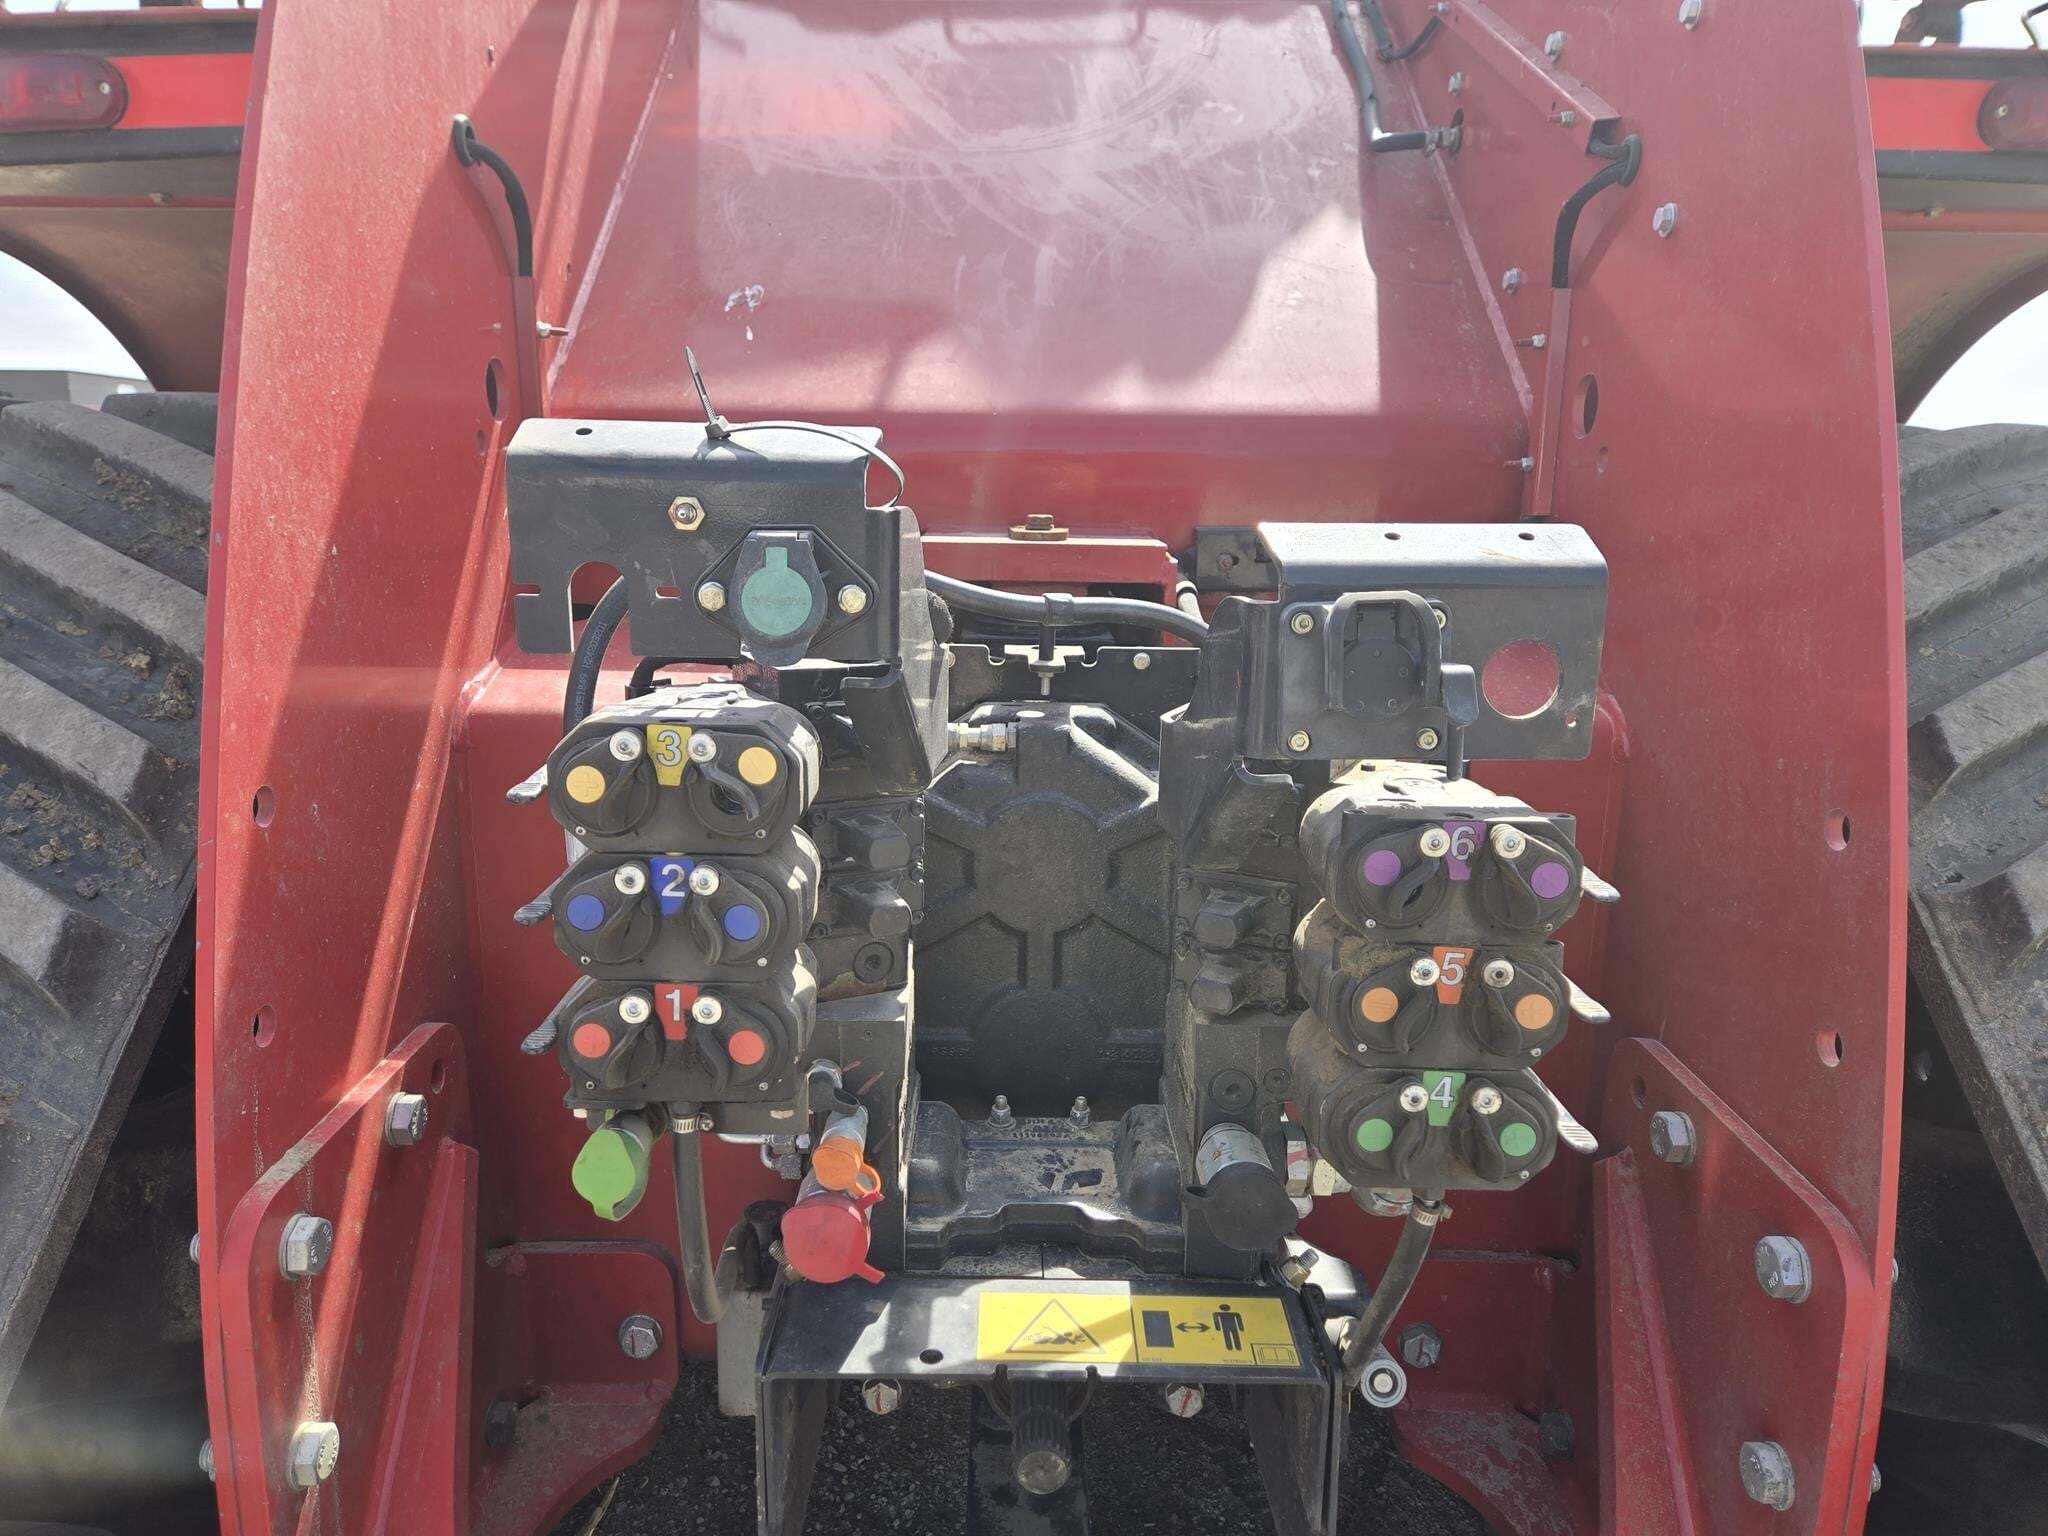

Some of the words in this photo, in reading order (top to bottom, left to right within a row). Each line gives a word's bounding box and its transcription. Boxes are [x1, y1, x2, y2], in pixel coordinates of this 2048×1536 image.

[655, 729, 683, 767] 3
[1450, 825, 1476, 861] 6
[660, 863, 686, 898] 2
[1439, 951, 1465, 987] 5
[665, 989, 682, 1022] 1
[1429, 1076, 1454, 1108] 4
